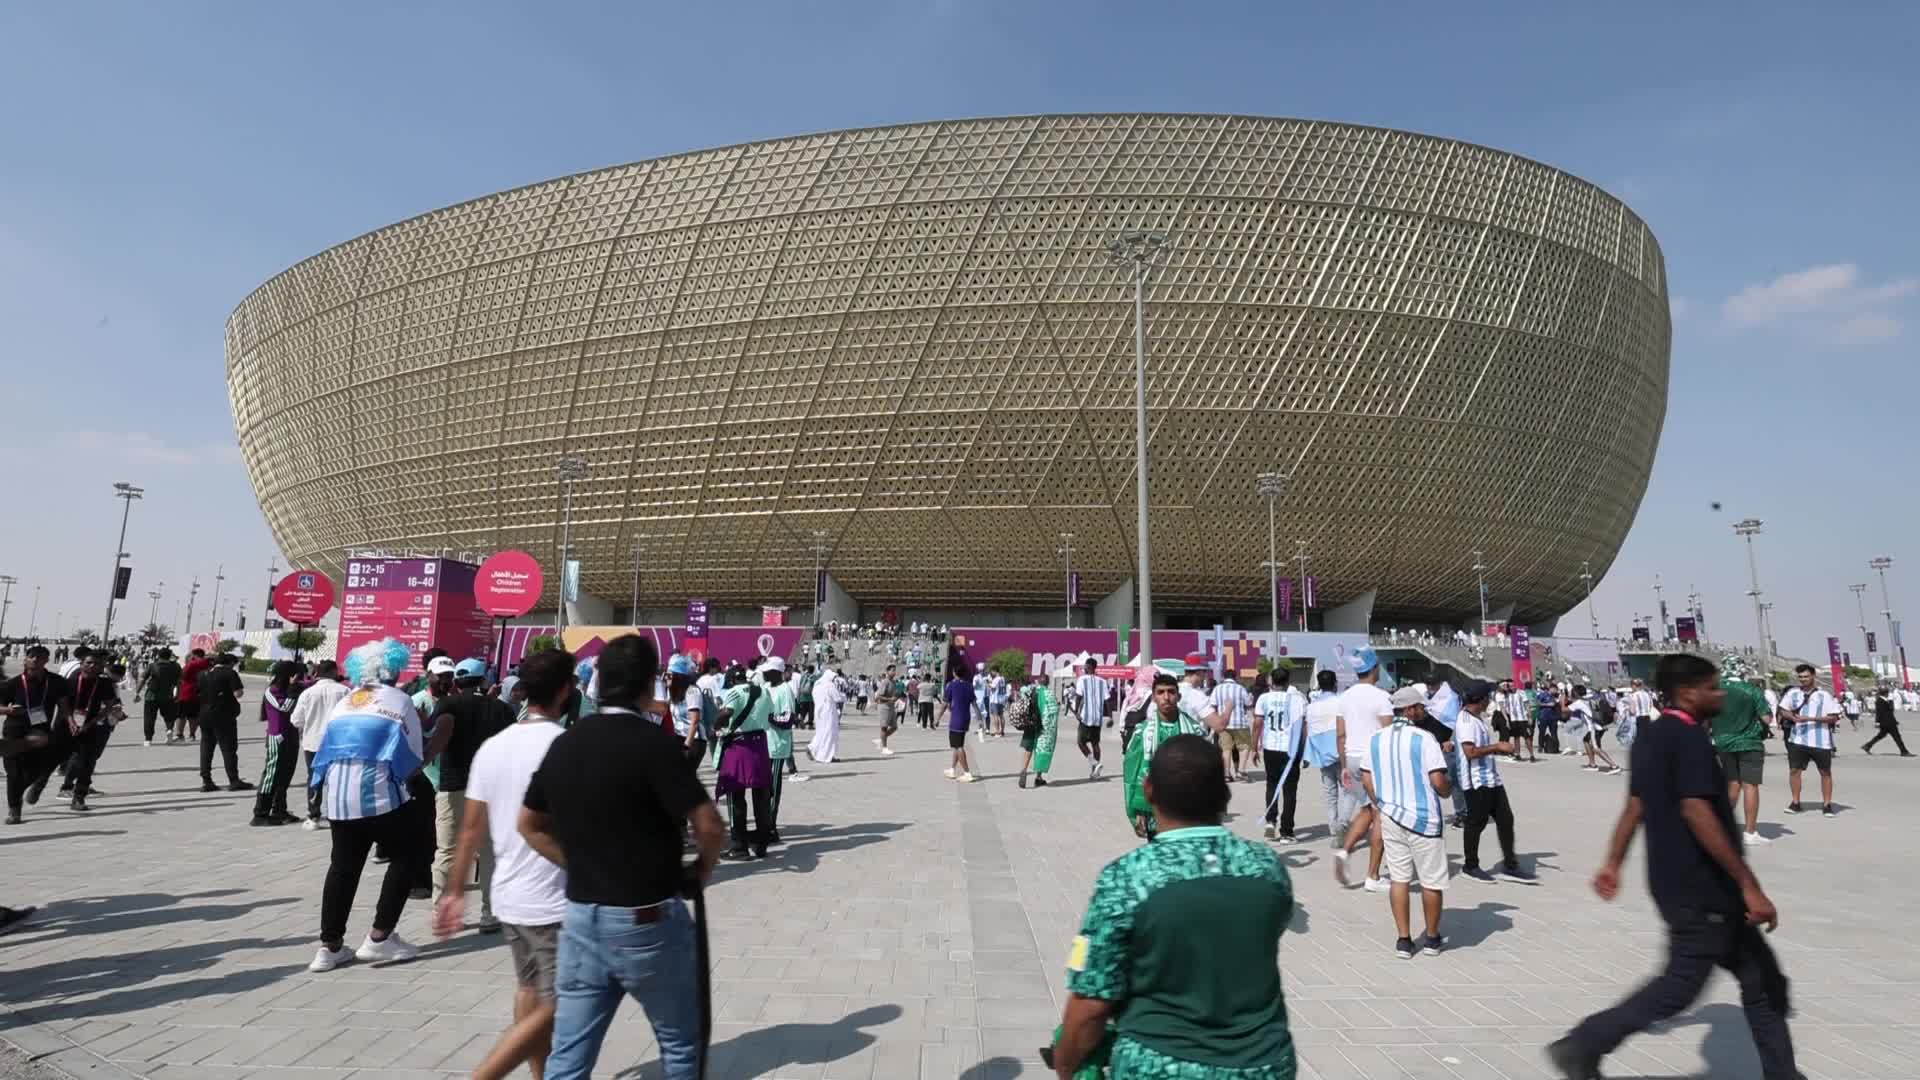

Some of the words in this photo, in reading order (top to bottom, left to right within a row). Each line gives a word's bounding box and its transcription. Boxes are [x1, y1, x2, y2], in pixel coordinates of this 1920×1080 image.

[361, 564, 385, 574] 12-15
[359, 577, 378, 587] 2-11
[407, 577, 434, 587] 16-40
